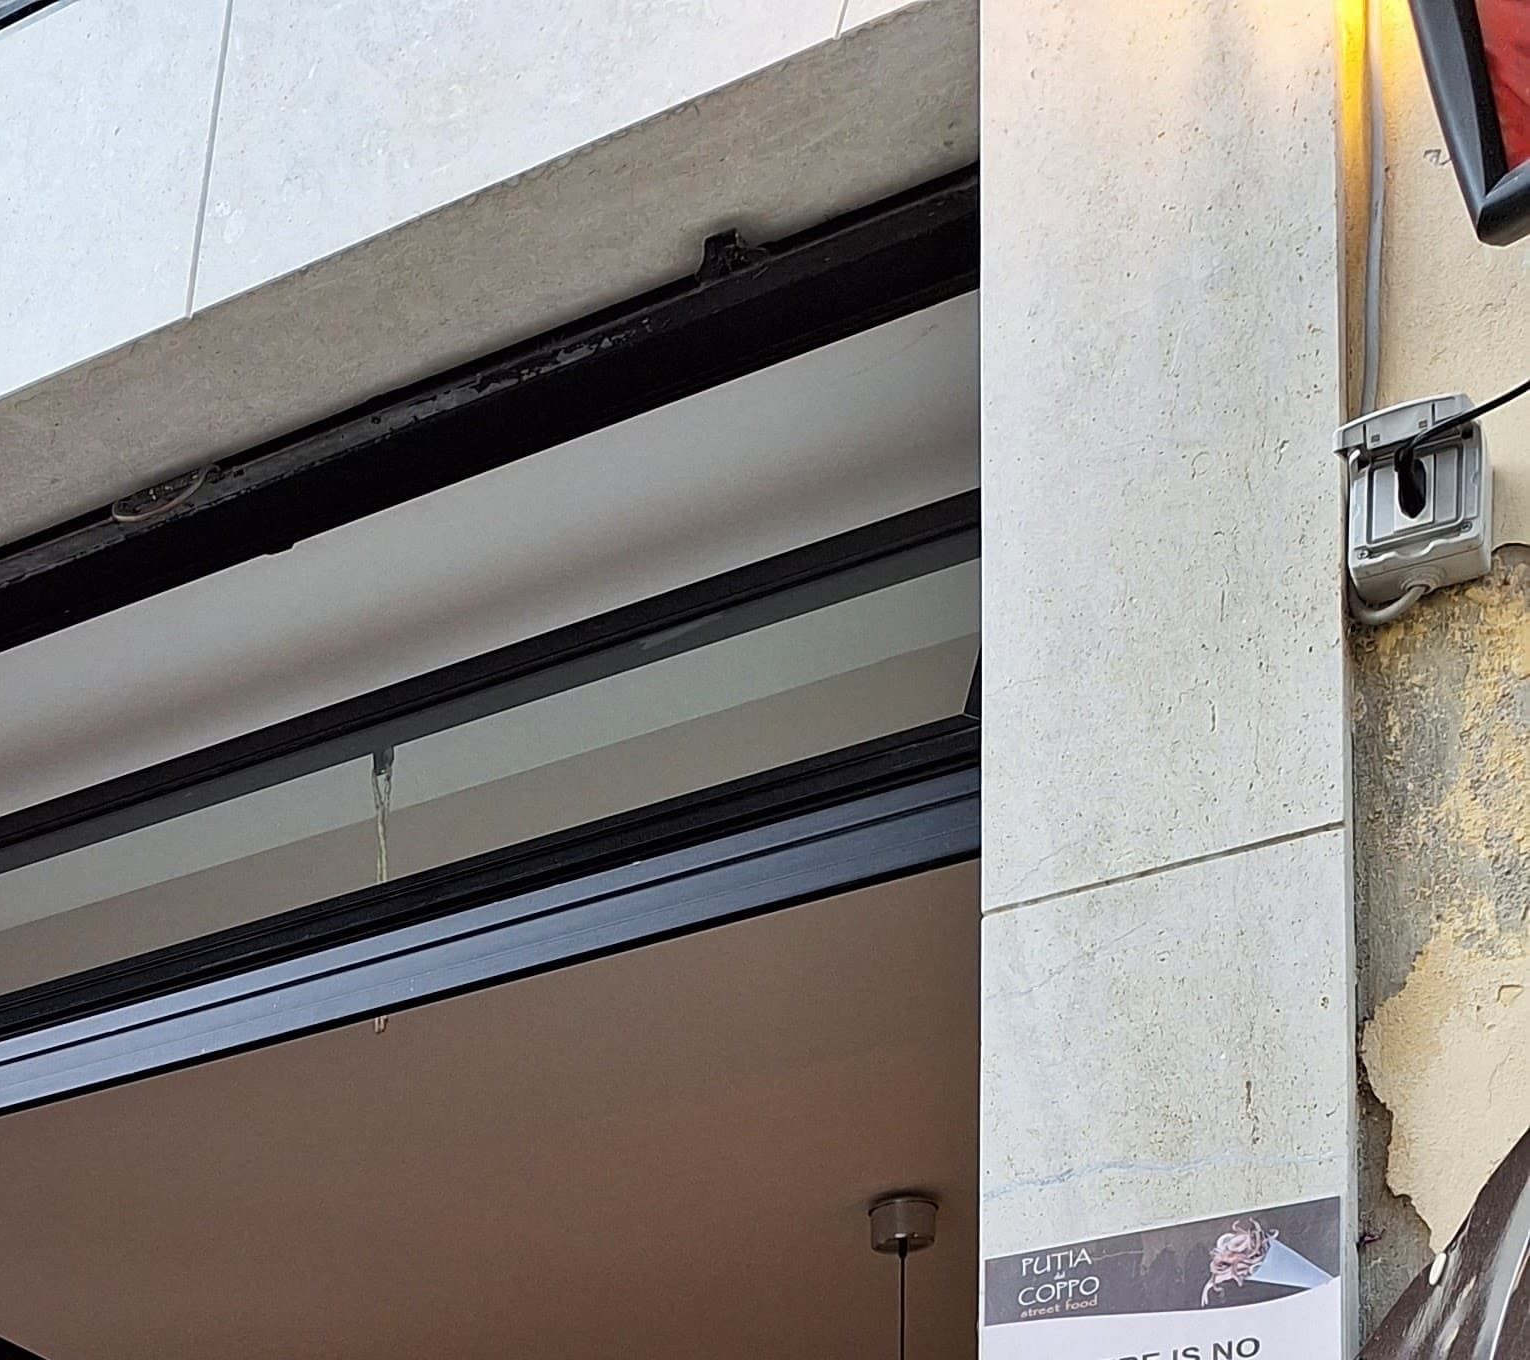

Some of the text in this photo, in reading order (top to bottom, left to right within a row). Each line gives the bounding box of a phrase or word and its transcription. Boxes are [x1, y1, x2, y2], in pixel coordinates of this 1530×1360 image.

[1021, 1247, 1092, 1277] PUTIA
[1017, 1275, 1100, 1308] COPPO
[1020, 1295, 1098, 1319] street food
